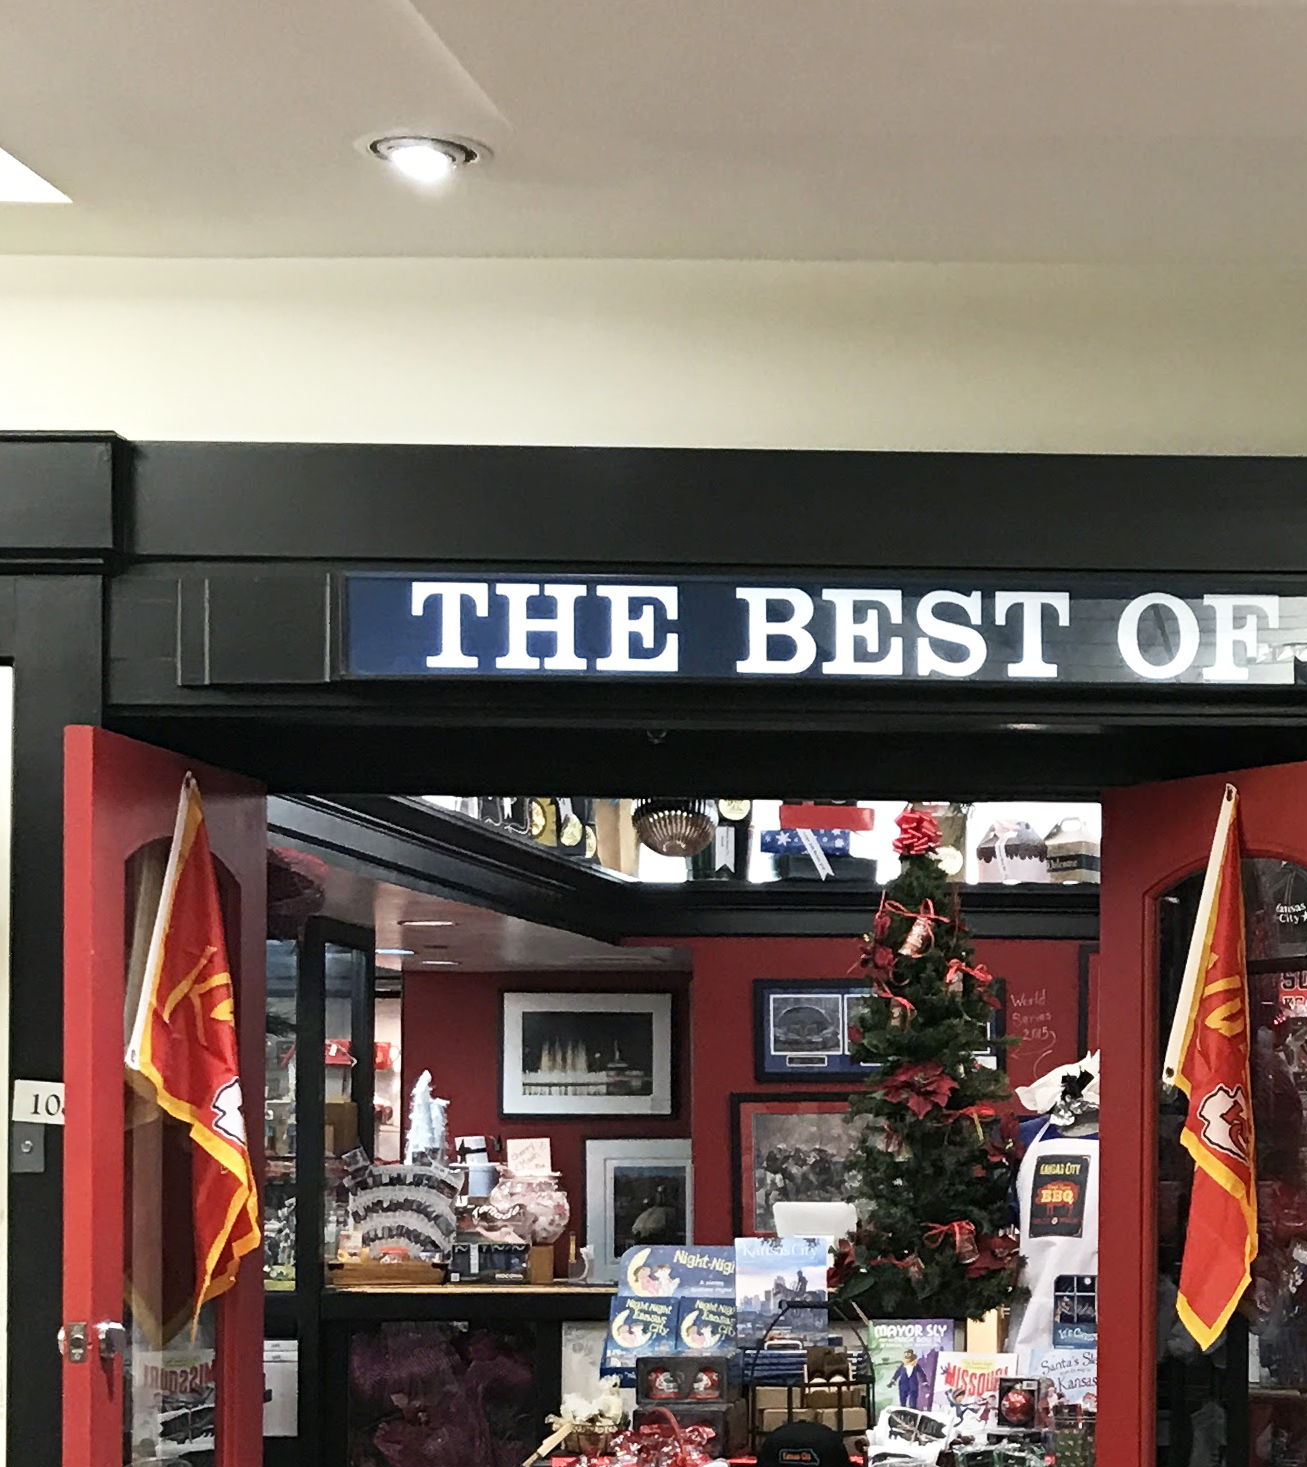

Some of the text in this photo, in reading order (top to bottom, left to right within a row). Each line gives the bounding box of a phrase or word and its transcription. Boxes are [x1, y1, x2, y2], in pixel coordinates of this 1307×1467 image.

[412, 582, 679, 671] THE
[736, 587, 1071, 678] BEST
[1117, 592, 1281, 683] OF
[1010, 989, 1046, 1007] World
[1023, 1027, 1049, 1041] 2015
[30, 1094, 66, 1116] 10
[1040, 1190, 1074, 1204] BBQ
[791, 1244, 818, 1259] City
[874, 1323, 947, 1338] MAYOR SLY
[1041, 1355, 1079, 1376] Santa's
